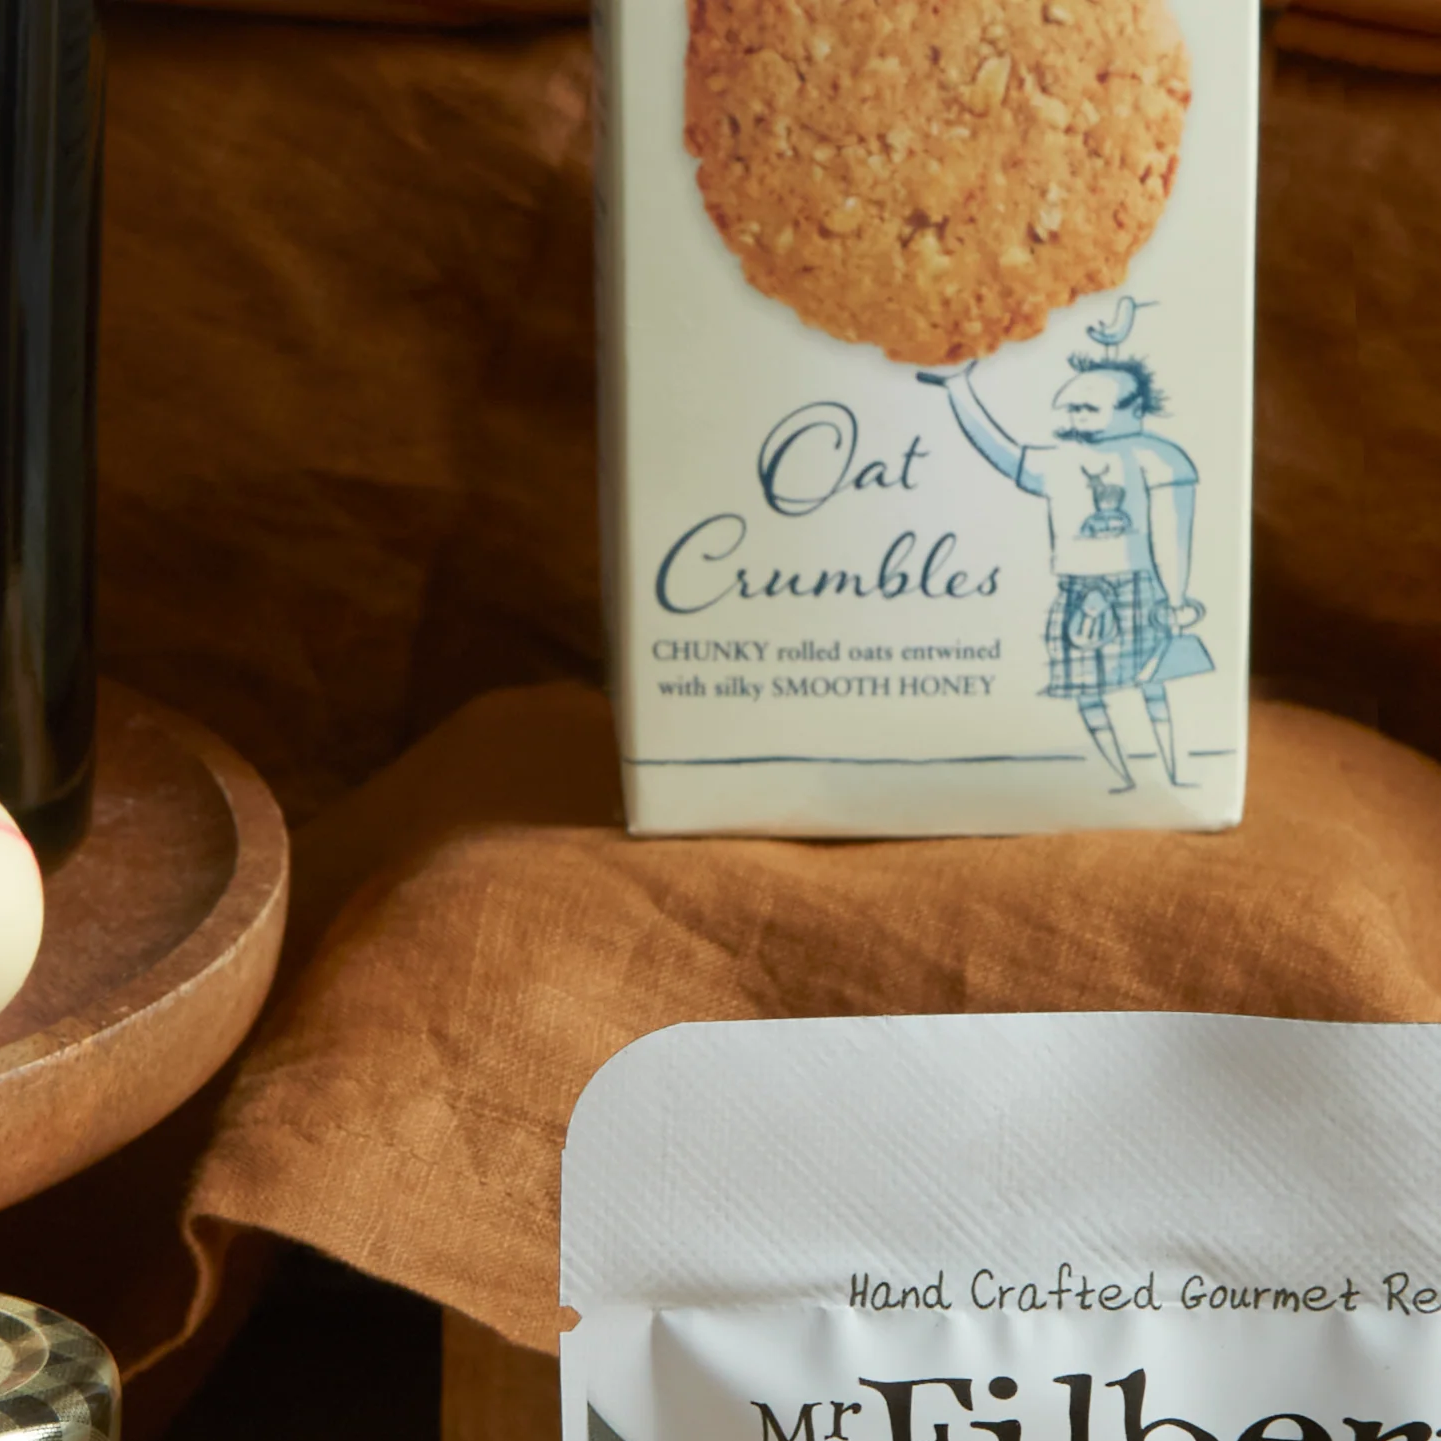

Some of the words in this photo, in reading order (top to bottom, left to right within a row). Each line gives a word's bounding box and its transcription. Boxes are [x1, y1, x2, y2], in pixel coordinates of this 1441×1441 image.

[758, 400, 931, 517] Oat
[654, 513, 1002, 615] Crumbles
[652, 639, 770, 662] CHUNKY
[777, 639, 840, 661] rolled
[848, 642, 893, 661] oats
[900, 638, 1001, 661] entwined
[657, 674, 706, 698] with
[714, 674, 763, 702] silky
[772, 675, 890, 698] SMOOTH
[899, 674, 996, 697] HONEY
[849, 1272, 952, 1311] Hand
[971, 1262, 1162, 1312] Crafted
[1180, 1273, 1360, 1313] Gourmet
